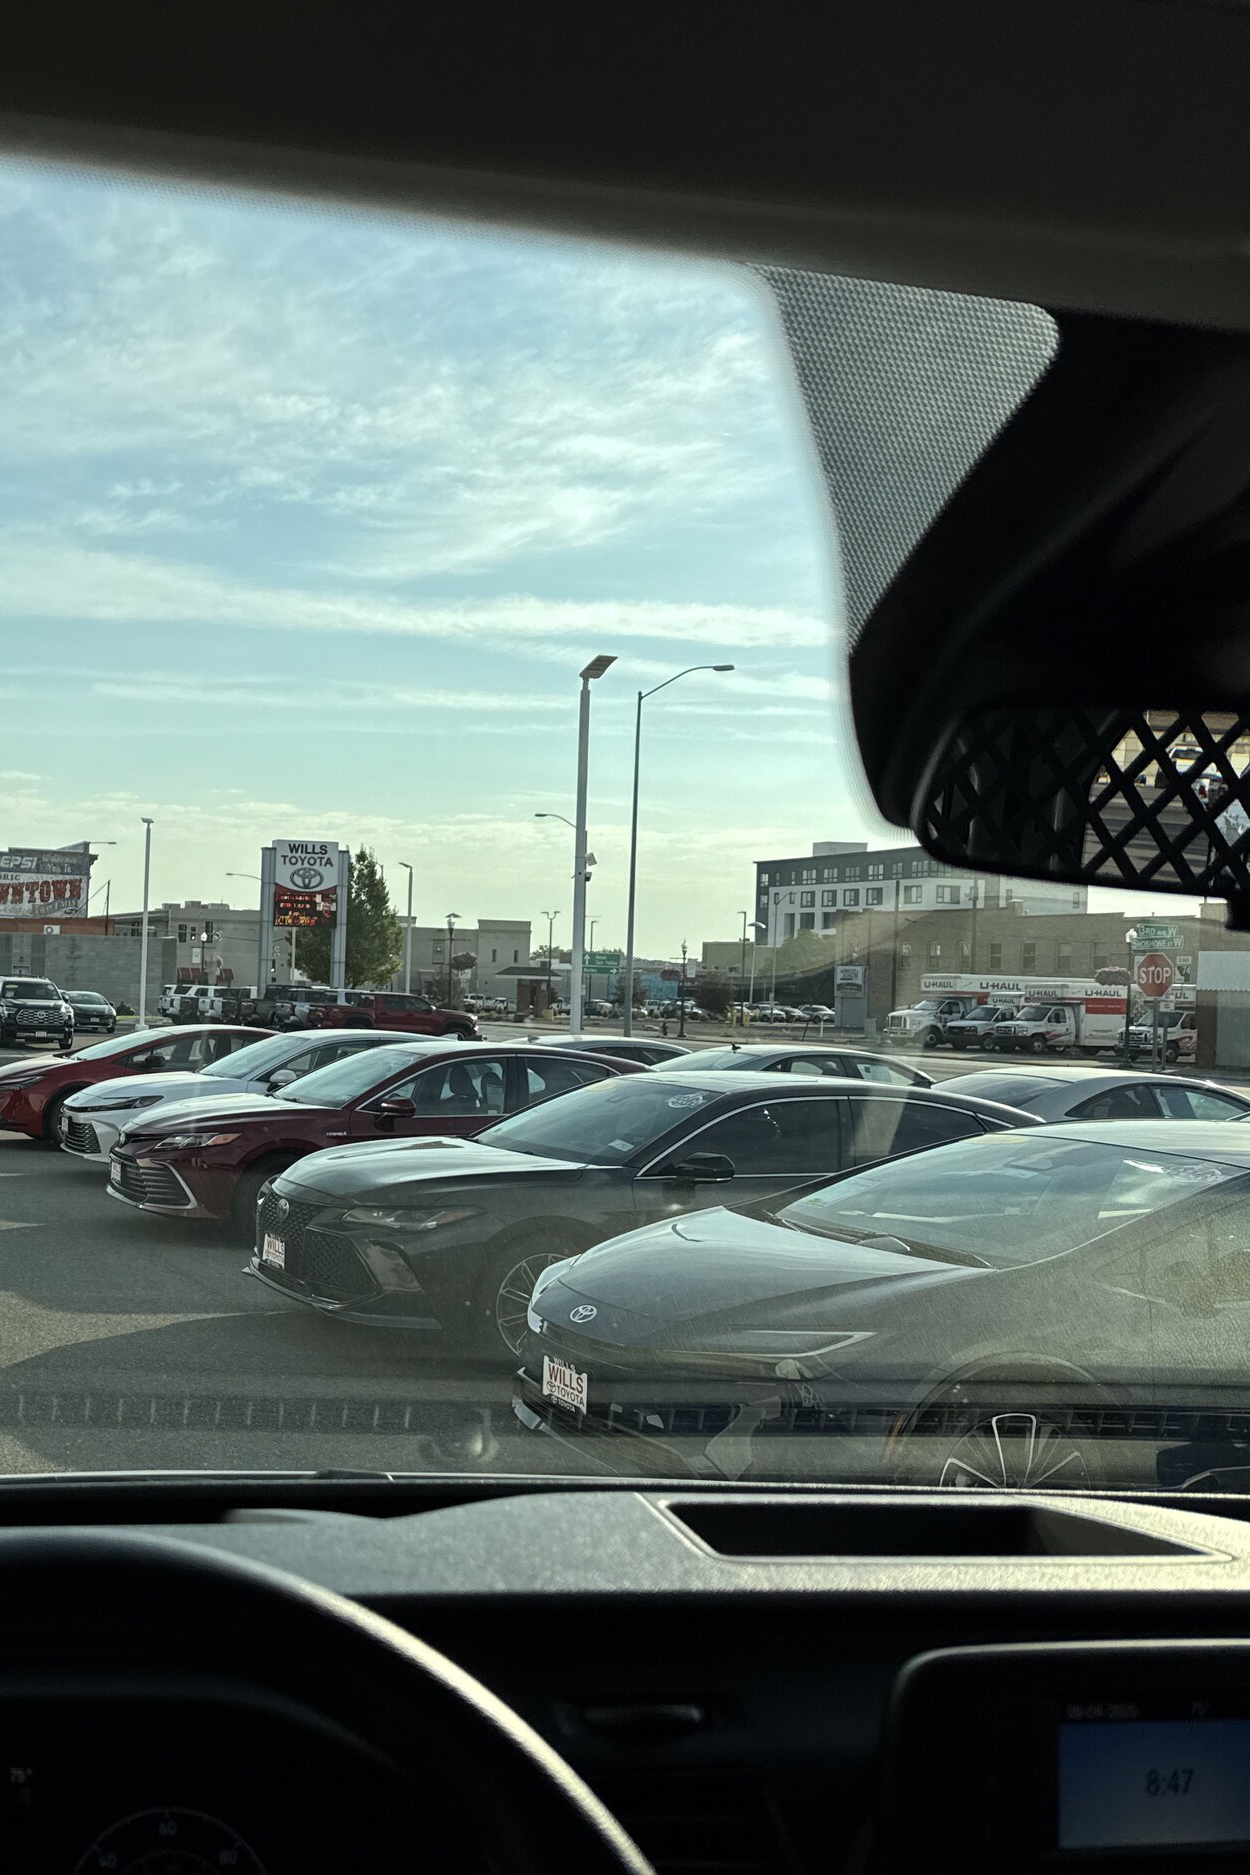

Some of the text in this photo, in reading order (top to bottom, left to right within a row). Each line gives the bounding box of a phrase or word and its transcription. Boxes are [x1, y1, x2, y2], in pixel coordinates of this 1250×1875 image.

[288, 843, 328, 855] WILLS
[281, 855, 333, 867] TOYOTA
[1139, 926, 1155, 936] 3RD
[1168, 927, 1177, 936] W
[1132, 939, 1166, 948] SHOSHONE
[1174, 938, 1182, 947] W
[1139, 967, 1171, 984] STOP
[548, 1363, 584, 1394] WILLS
[557, 1385, 585, 1408] TOYOTA
[1145, 1767, 1196, 1796] 8:47
